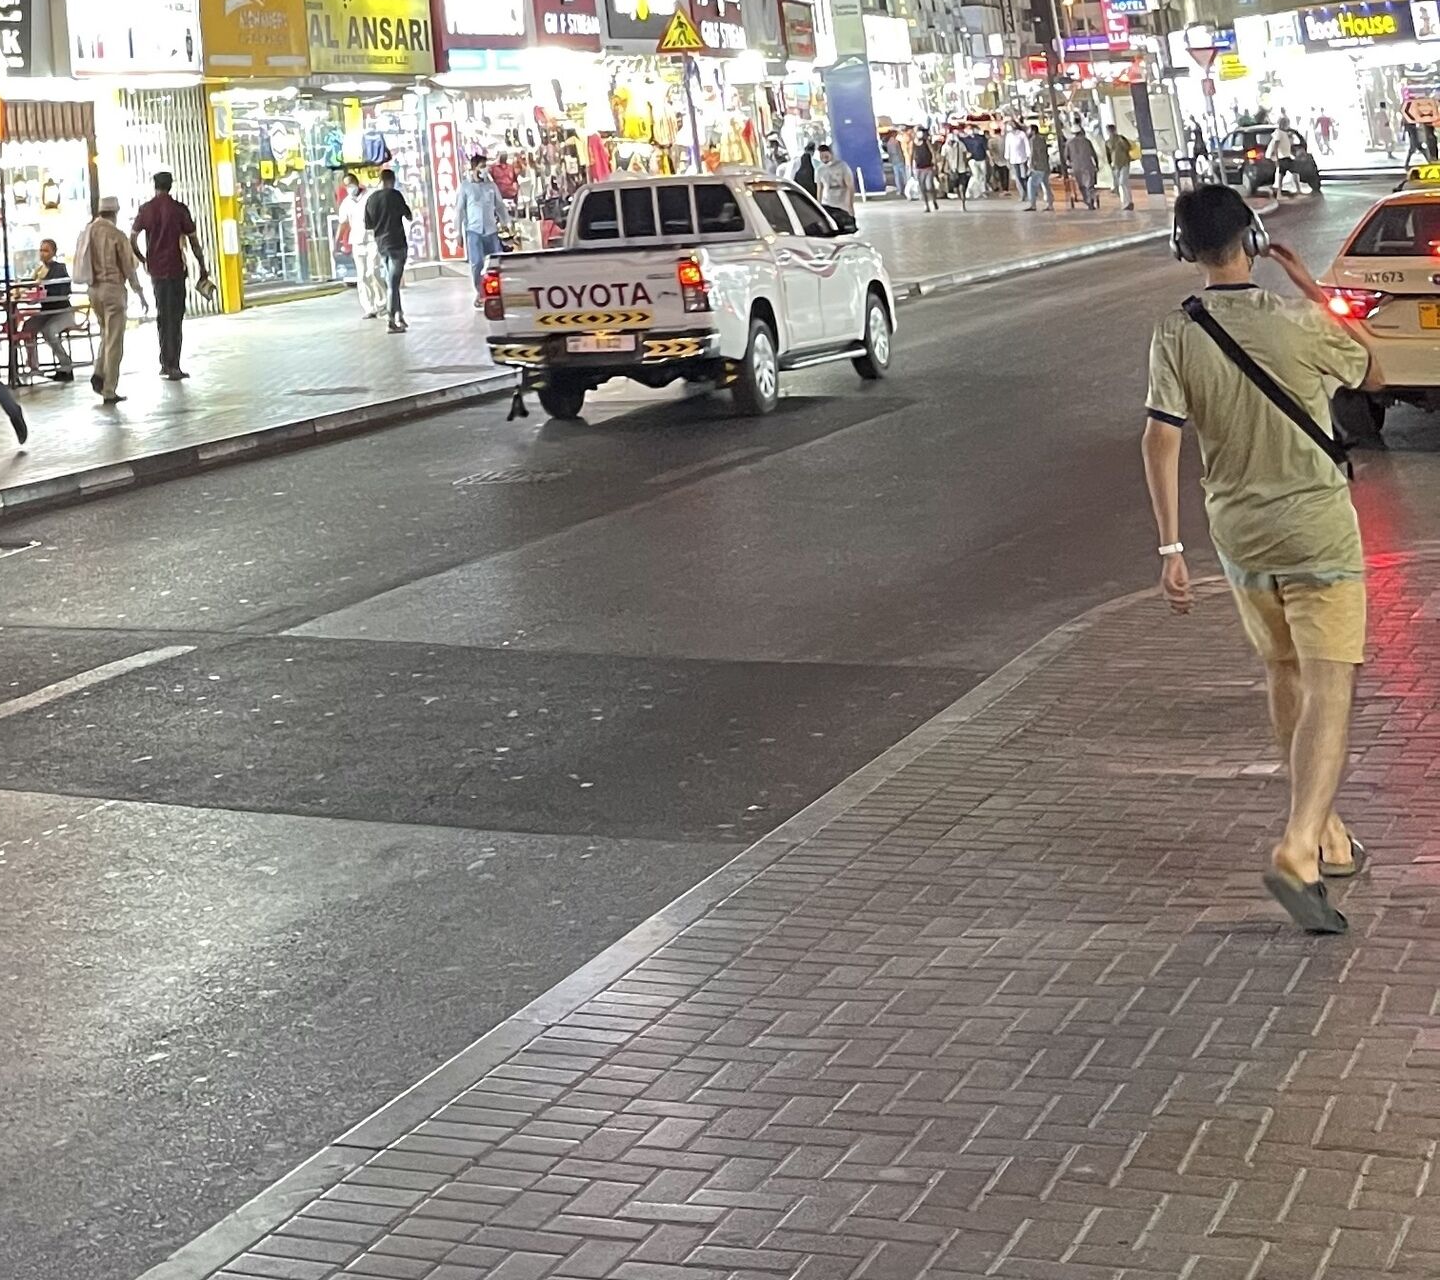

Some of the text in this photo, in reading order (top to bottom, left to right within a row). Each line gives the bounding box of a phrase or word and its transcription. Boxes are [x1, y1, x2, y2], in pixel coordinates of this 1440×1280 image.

[310, 14, 339, 48] AL
[347, 16, 430, 51] ANSARI
[433, 124, 460, 257] PHARMACY
[1363, 272, 1405, 284] MT673
[528, 282, 653, 310] TOYOTA
